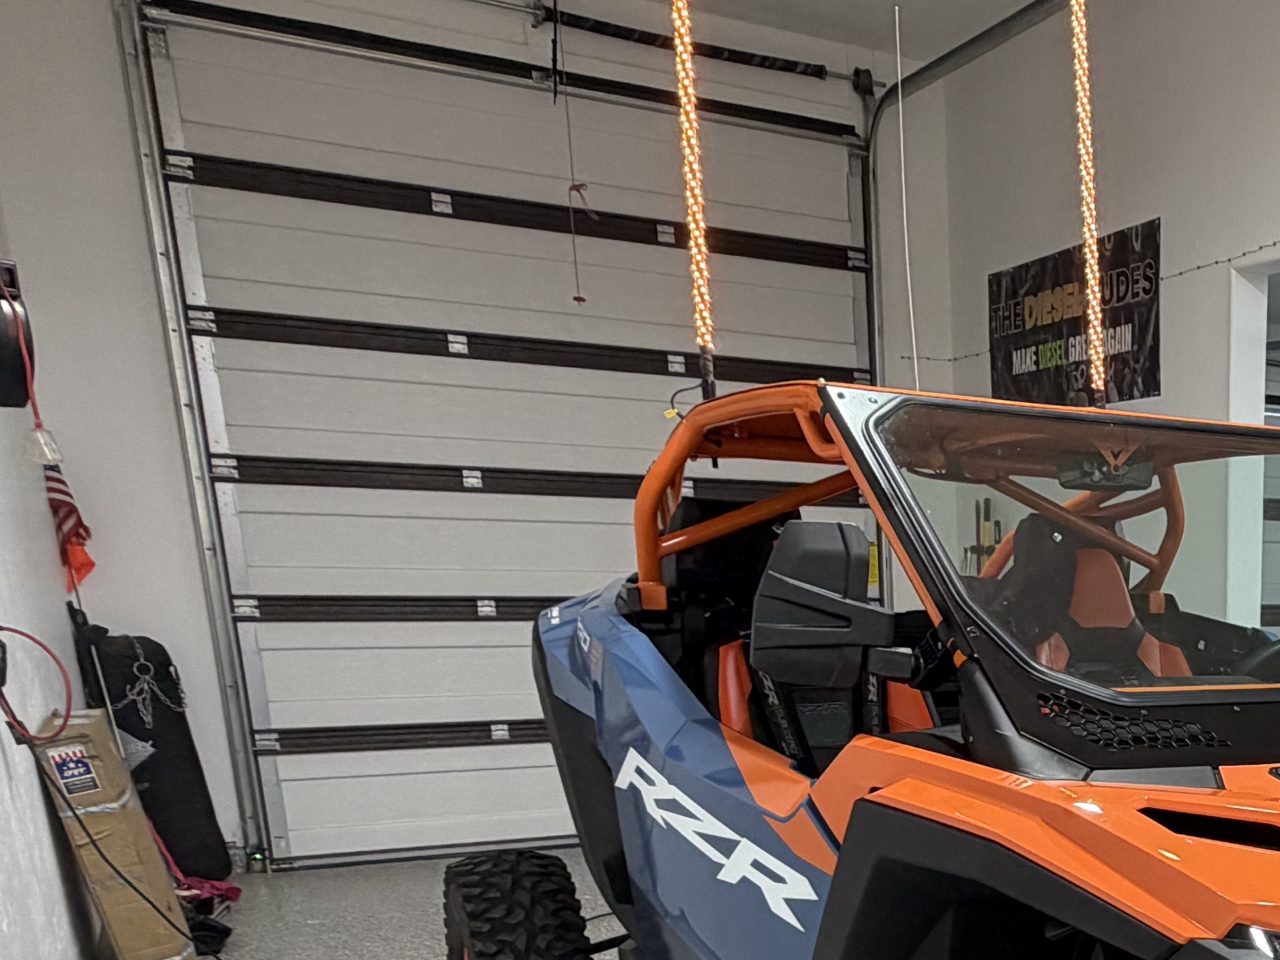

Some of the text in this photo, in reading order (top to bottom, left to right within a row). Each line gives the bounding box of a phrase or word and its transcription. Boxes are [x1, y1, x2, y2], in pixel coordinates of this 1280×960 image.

[991, 259, 1156, 337] THE DIESEL UDES
[1012, 345, 1038, 376] MAKE
[1038, 339, 1068, 369] DIESEL
[1068, 334, 1089, 363] GRE
[614, 746, 819, 933] RZR
